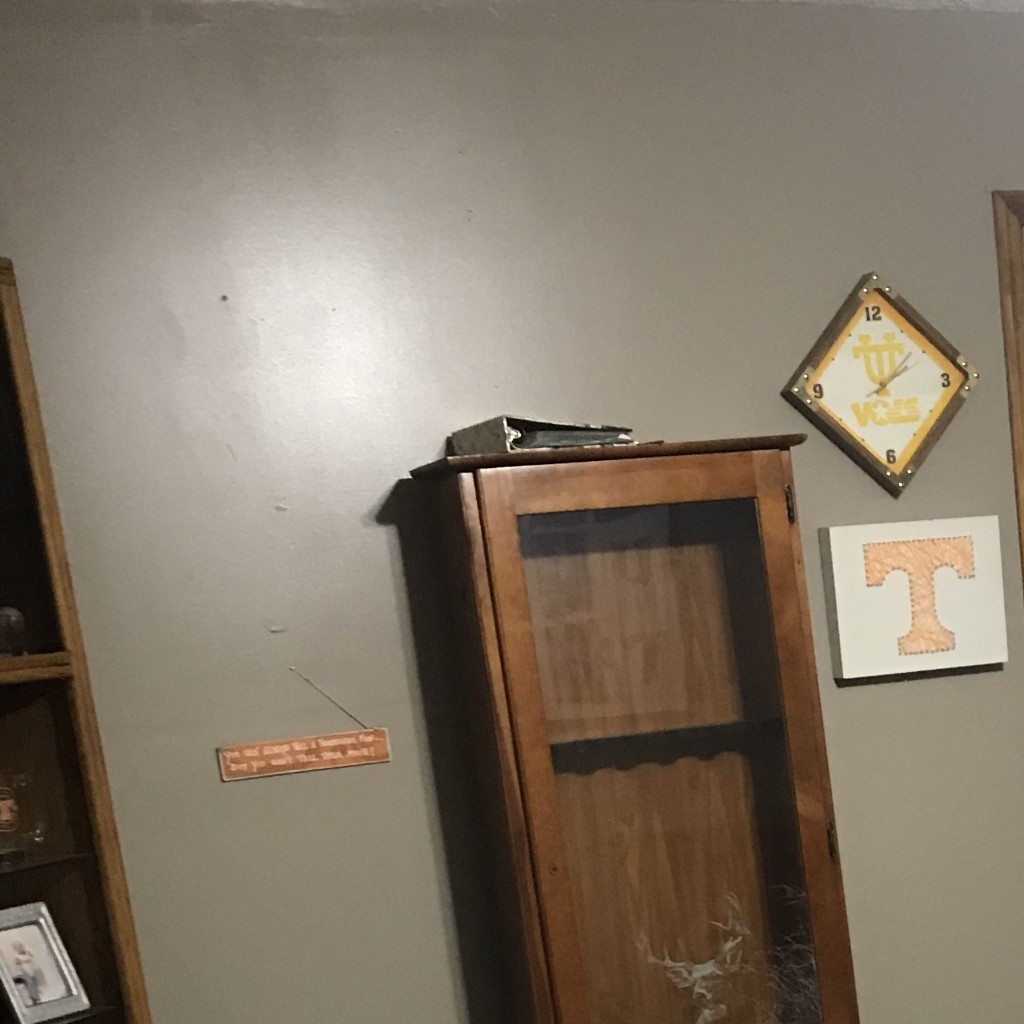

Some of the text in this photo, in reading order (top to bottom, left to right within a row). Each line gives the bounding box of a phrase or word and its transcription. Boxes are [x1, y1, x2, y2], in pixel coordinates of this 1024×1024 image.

[864, 305, 882, 322] 12
[940, 372, 951, 388] 3
[812, 383, 824, 399] 9
[885, 448, 897, 464] 6
[862, 534, 976, 656] T
